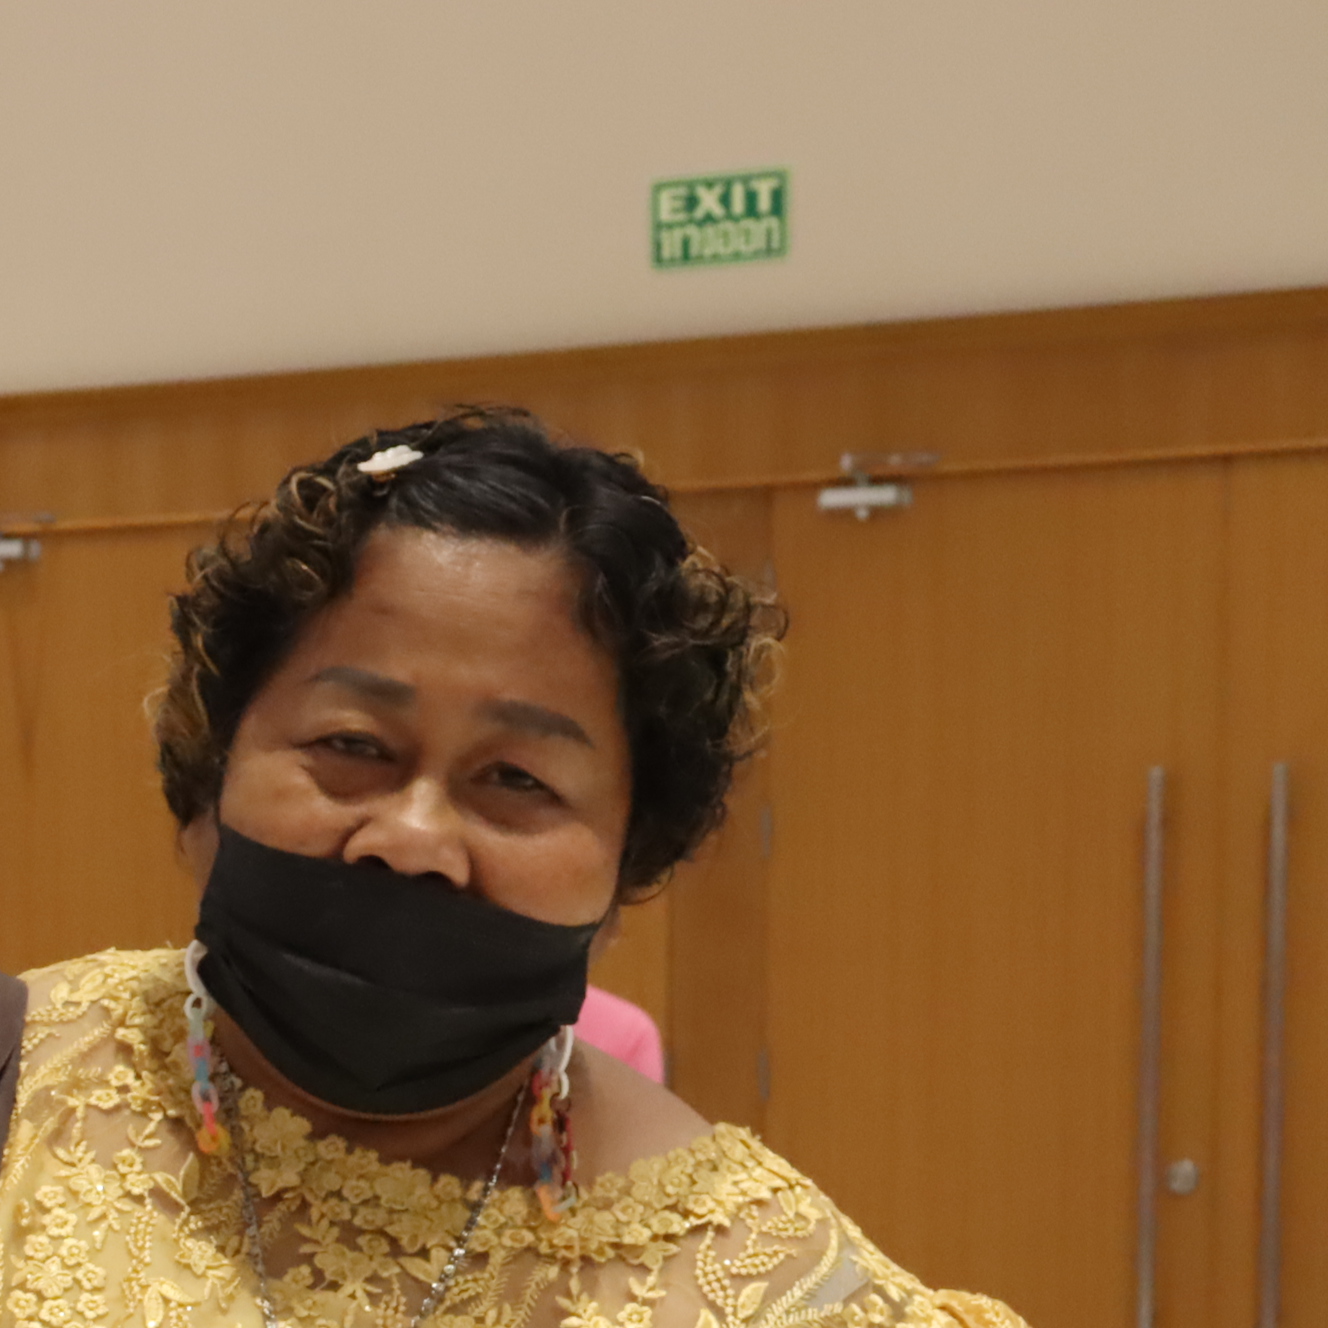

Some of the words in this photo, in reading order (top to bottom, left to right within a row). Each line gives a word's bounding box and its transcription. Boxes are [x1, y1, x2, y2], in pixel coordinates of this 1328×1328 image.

[658, 177, 779, 222] EXIT
[659, 215, 781, 261] ทางออก
